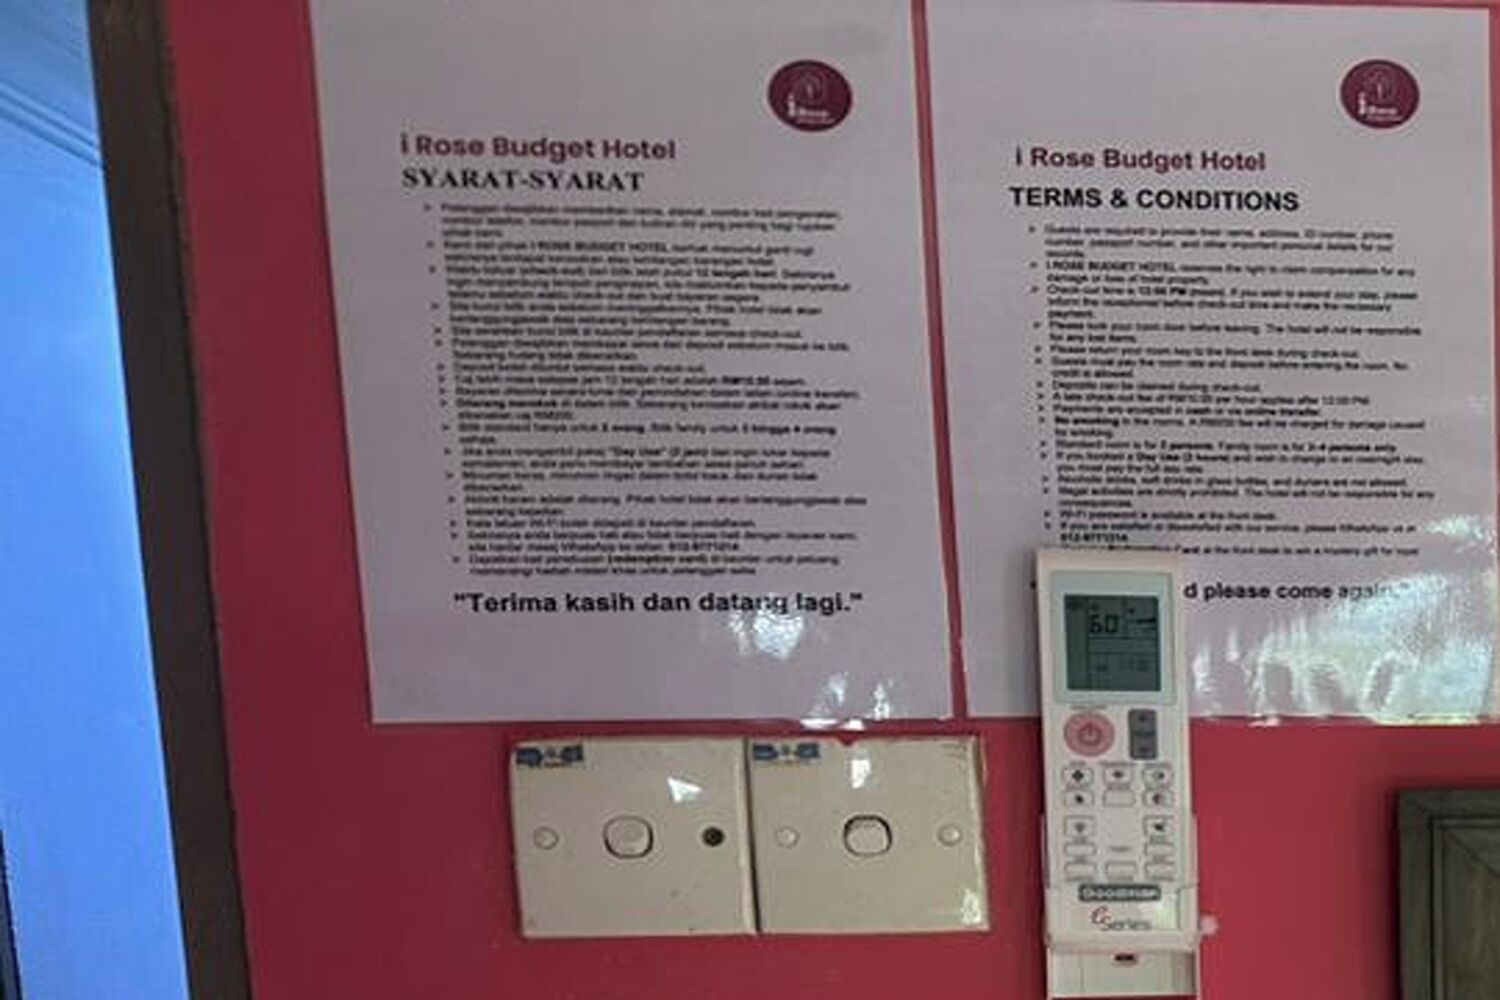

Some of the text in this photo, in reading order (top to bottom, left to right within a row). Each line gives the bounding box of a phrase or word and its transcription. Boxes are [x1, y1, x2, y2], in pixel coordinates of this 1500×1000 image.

[416, 136, 484, 156] Rose
[493, 136, 596, 164] Budget
[603, 139, 676, 159] Hotel
[1031, 147, 1094, 168] Rose
[1104, 149, 1193, 174] Budget
[1201, 152, 1266, 171] Hotel
[402, 168, 644, 191] SYARAT-SYARAT
[1009, 187, 1300, 211] TERMS & CONDITIONS
[454, 592, 557, 614] "Terima
[566, 592, 635, 612] kasih
[642, 592, 690, 612] dan
[698, 592, 788, 615] datang
[1203, 583, 1271, 602] please
[1275, 584, 1333, 599] come
